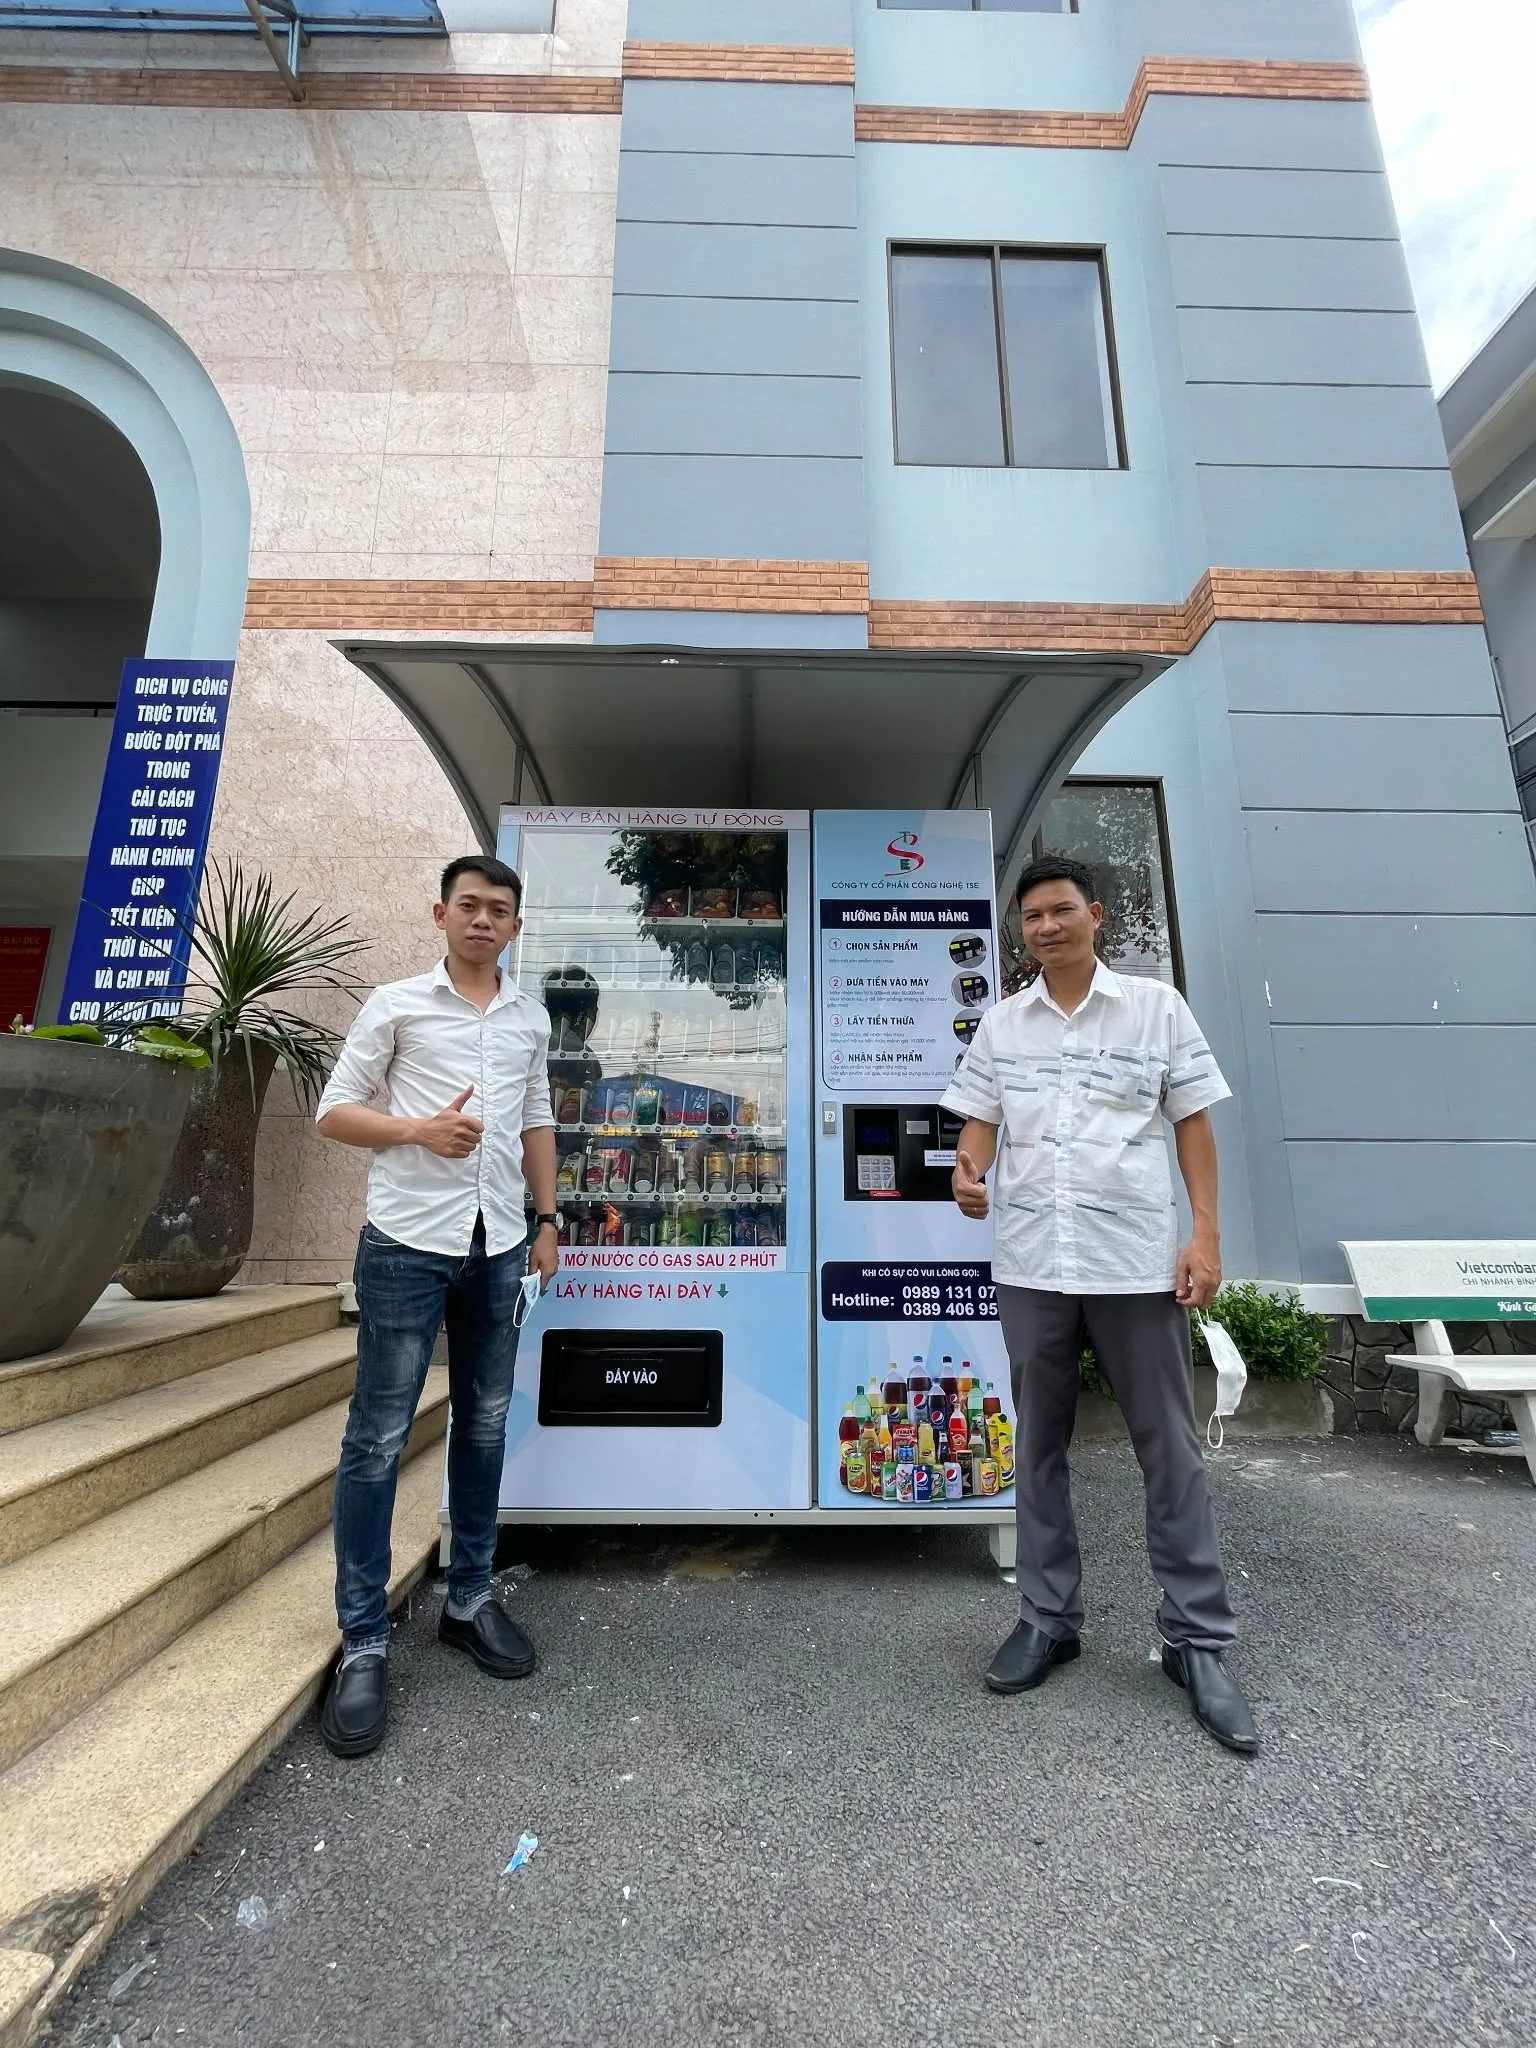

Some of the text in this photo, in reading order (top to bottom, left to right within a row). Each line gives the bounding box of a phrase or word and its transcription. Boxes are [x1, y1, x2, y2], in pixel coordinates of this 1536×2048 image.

[135, 676, 228, 698] DỊCH VỤ CÔNG
[138, 701, 218, 726] TRỰC TUYẾN,
[124, 730, 220, 754] BƯỚC ĐỘT PHÁ
[146, 761, 190, 778] TRONG
[131, 786, 196, 807] CẢI CÁCH
[526, 810, 784, 827] MÁY BÁN HÀNG TỰ ĐỘNG
[130, 815, 186, 840] THỦ TỤC
[110, 844, 195, 866] HÀNH CHÍNH
[131, 875, 165, 896] GIÚP
[831, 880, 858, 889] CÔNG
[912, 880, 938, 889] CÔNG
[940, 881, 964, 890] NGHỆ
[110, 902, 176, 930] TIẾT KIỆM
[842, 906, 969, 922] HƯỚNG DẪN MUA HÀNG
[104, 936, 173, 958] THỜI GIAN
[846, 942, 870, 952] CHỌN
[872, 940, 890, 950] SẢN
[892, 938, 918, 950] PHẨM
[94, 967, 172, 989] VÀ CHI PHÍ
[846, 976, 864, 986] ĐƯA
[890, 976, 908, 986] VÀO
[910, 976, 930, 986] MÁY
[70, 1001, 100, 1021] CHO
[848, 1014, 864, 1026] LẤY
[848, 1052, 872, 1064] NHẬN
[876, 1050, 893, 1062] SẢN
[896, 1050, 922, 1062] PHẨM
[564, 1250, 778, 1266] MỞ NƯỚC CÓ GAS SAU 2 PHÚT
[862, 1268, 876, 1276] KHI
[878, 1267, 890, 1276] CÓ
[892, 1268, 905, 1278] SỰ
[920, 1268, 934, 1276] VUI
[936, 1268, 960, 1276] LÒNG
[962, 1268, 980, 1278] GỌI:
[556, 1278, 712, 1302] LẤY HÀNG TẠI ĐÂY
[902, 1286, 940, 1298] 0989
[946, 1286, 972, 1298] 131
[832, 1292, 894, 1306] Hotline:
[903, 1302, 940, 1316] 0389
[946, 1302, 974, 1316] 406
[632, 1368, 658, 1384] VÀO
